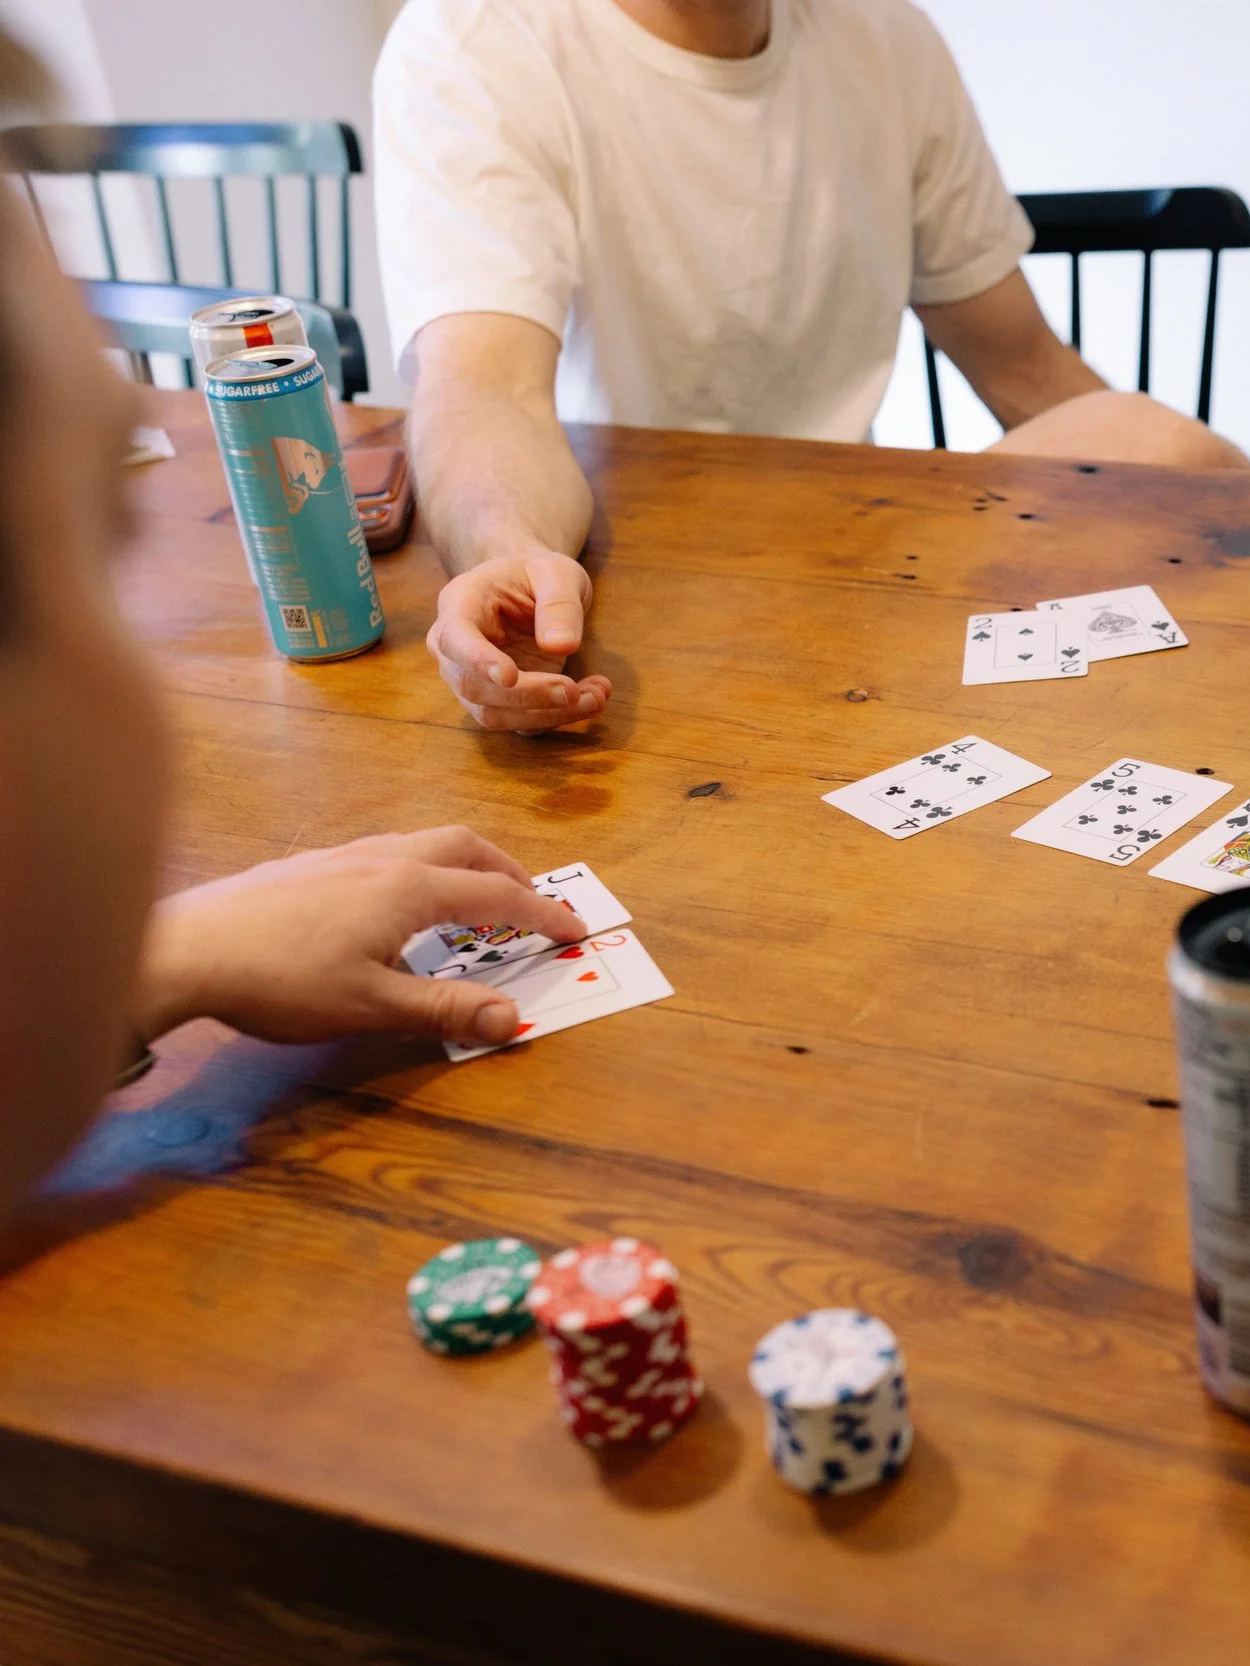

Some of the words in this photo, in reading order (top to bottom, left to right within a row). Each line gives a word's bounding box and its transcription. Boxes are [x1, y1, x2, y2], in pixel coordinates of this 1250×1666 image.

[215, 381, 280, 397] SUGARFREE
[973, 617, 992, 630] 2
[1158, 631, 1178, 644] A
[1060, 659, 1080, 674] 2
[950, 741, 978, 755] 4
[1110, 762, 1142, 779] 5
[891, 817, 921, 831] 4
[1109, 843, 1142, 862] 5
[547, 870, 584, 885] J
[590, 934, 628, 952] 2
[427, 962, 468, 977] J
